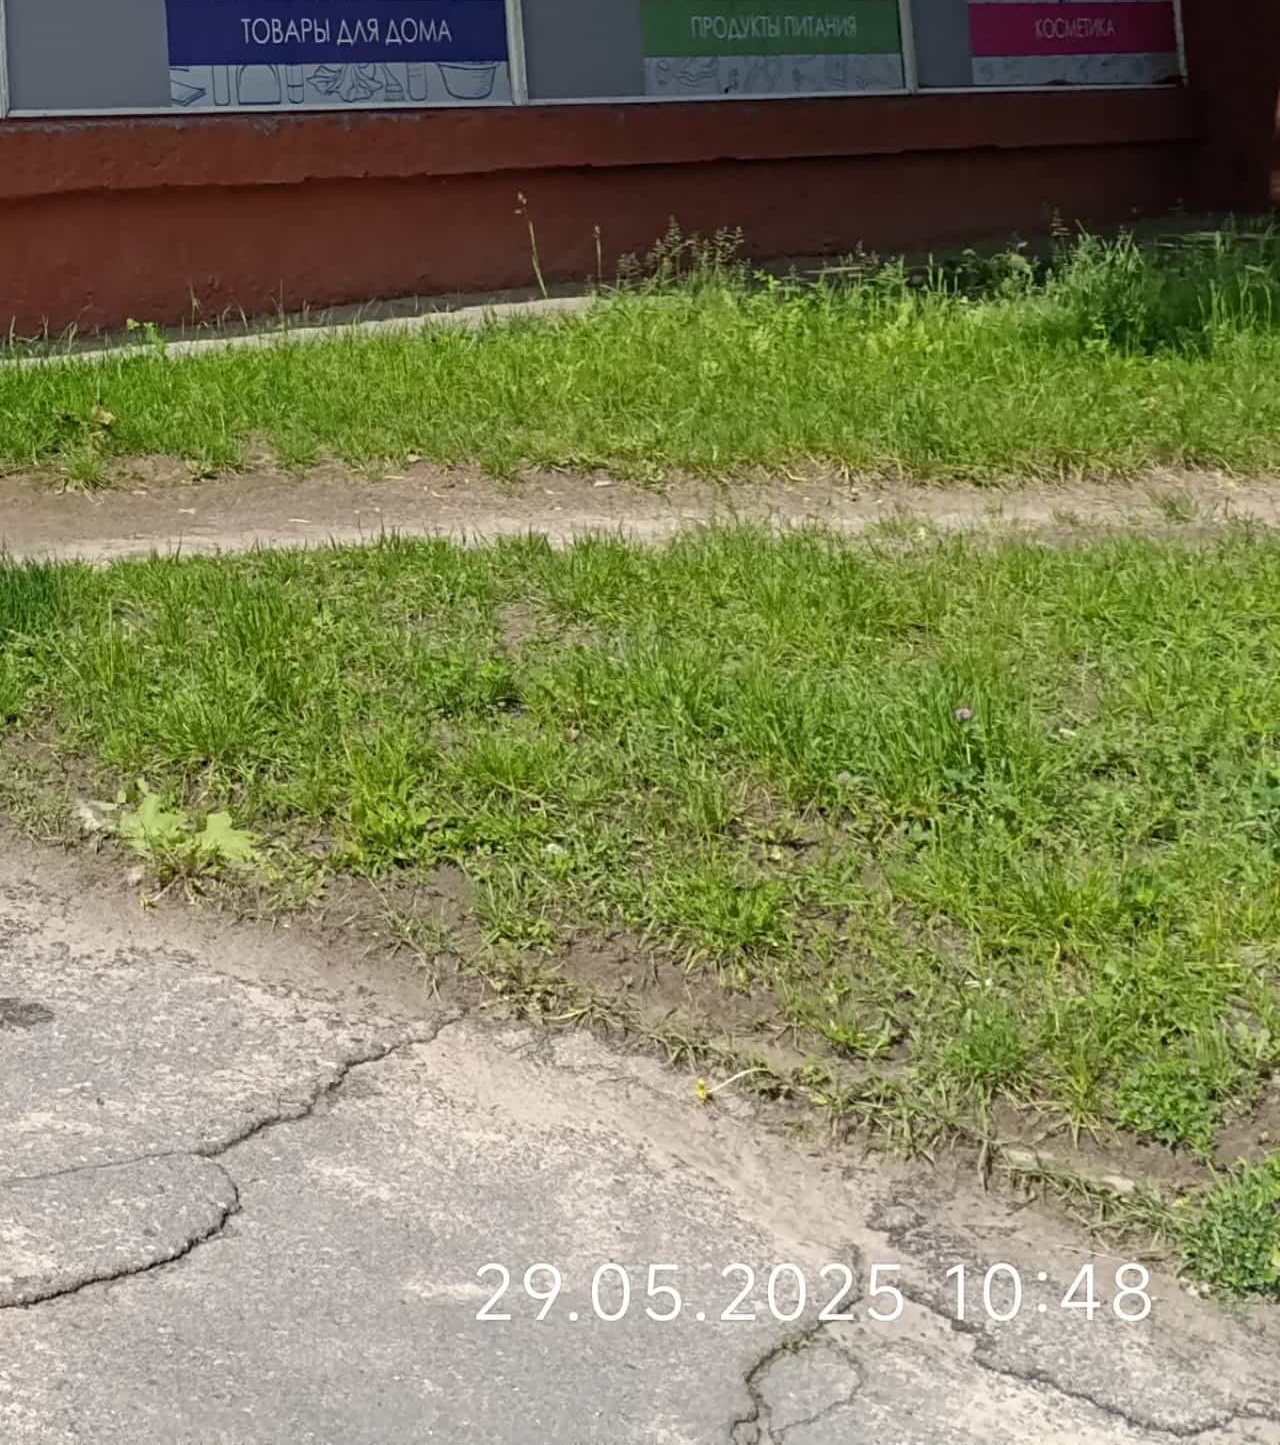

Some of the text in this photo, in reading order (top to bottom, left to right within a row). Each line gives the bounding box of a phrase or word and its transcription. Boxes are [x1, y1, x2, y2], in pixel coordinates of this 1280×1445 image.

[240, 17, 452, 46] ТОВАРЫ ДЛЯ ДОМА
[691, 16, 857, 41] ПРОДУКТЫ ПИТАНИЯ
[1033, 17, 1118, 39] КОСМЕТИКА
